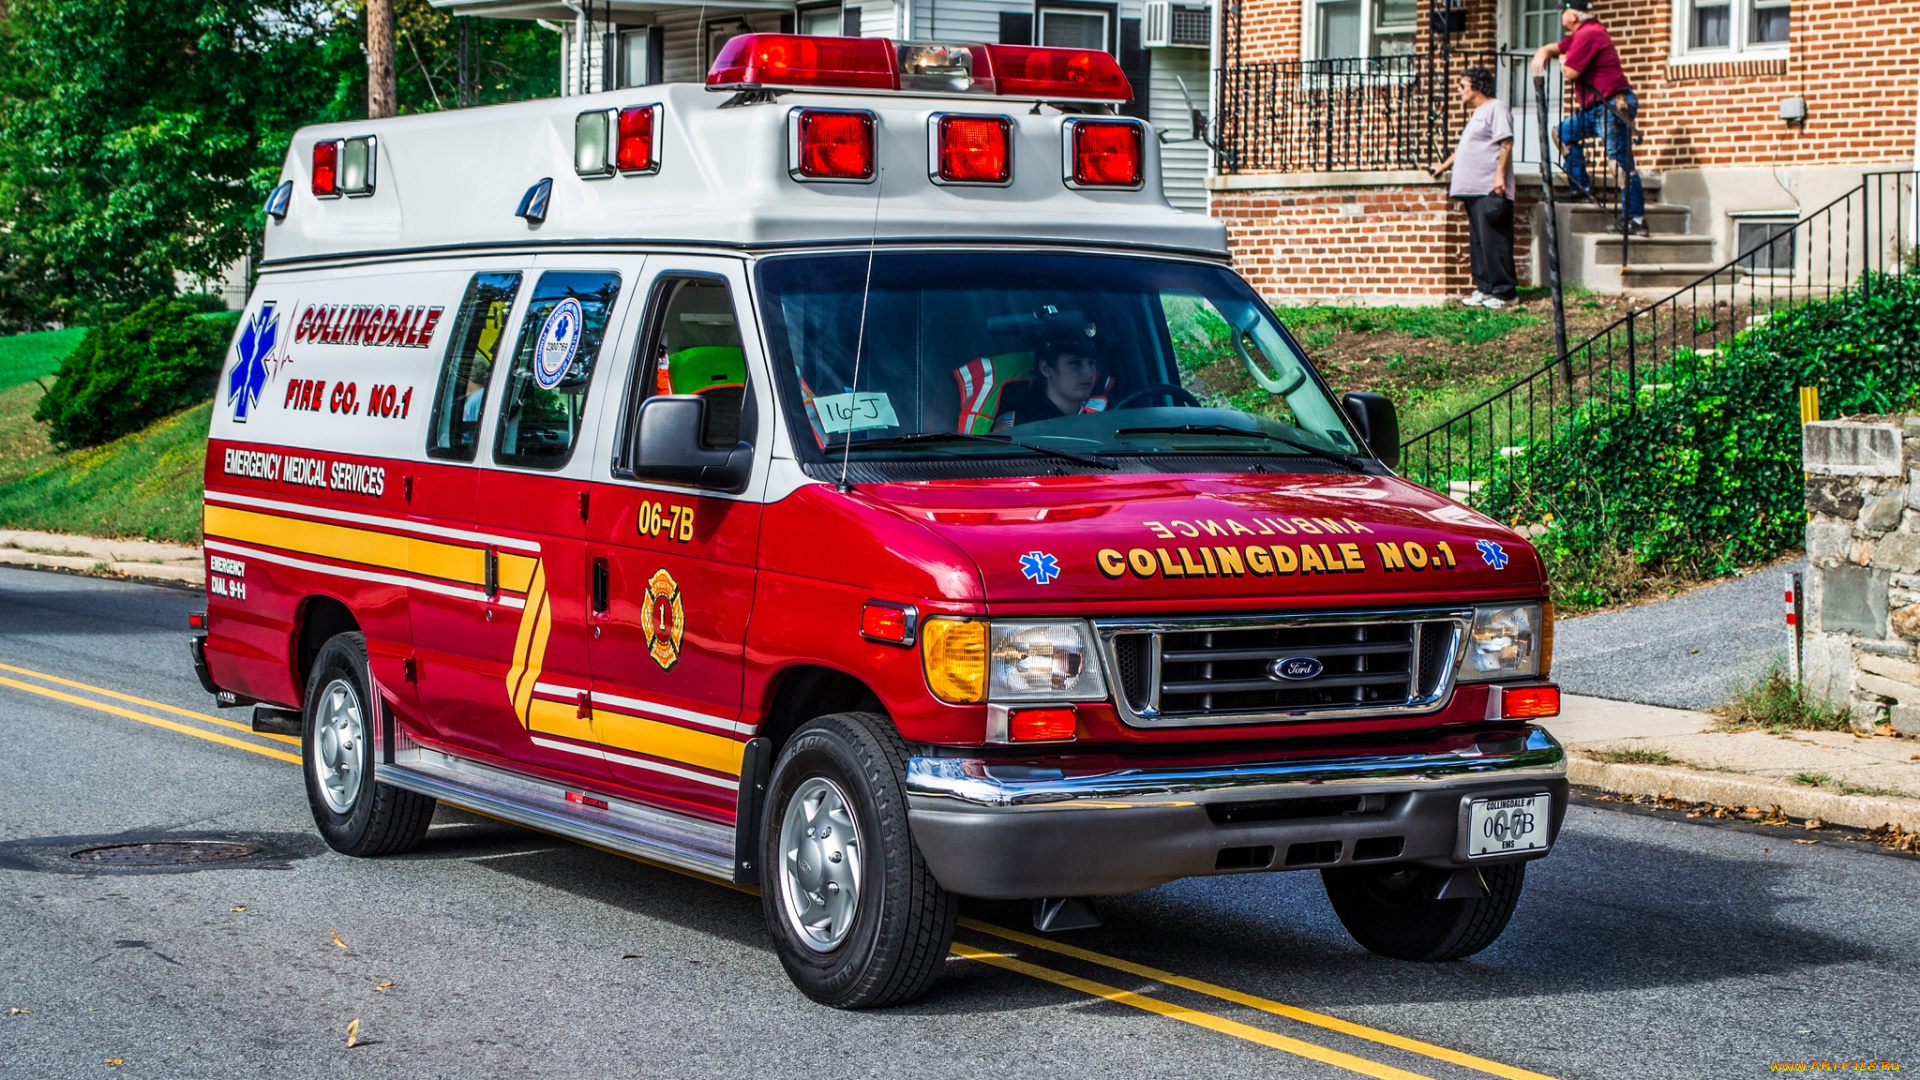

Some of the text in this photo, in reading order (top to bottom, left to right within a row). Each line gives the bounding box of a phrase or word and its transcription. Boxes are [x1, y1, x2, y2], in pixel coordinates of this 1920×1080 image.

[295, 303, 445, 348] COLLINGDALE
[284, 378, 413, 419] FIRE CO. NO.1
[826, 398, 880, 421] 16-J
[224, 448, 386, 497] EMERGENCY MEDICAL SERVICES
[638, 500, 694, 543] 06-7B
[210, 555, 246, 578] EMERGENCY
[1096, 540, 1457, 580] COLLINGDALE NO.1
[211, 576, 246, 600] DIAL 9-1-1
[659, 603, 666, 630] 1
[1287, 661, 1313, 675] Ford
[1486, 798, 1535, 811] COLLINGDALE #1
[1484, 813, 1534, 838] 06-7B
[1502, 840, 1514, 849] EMS
